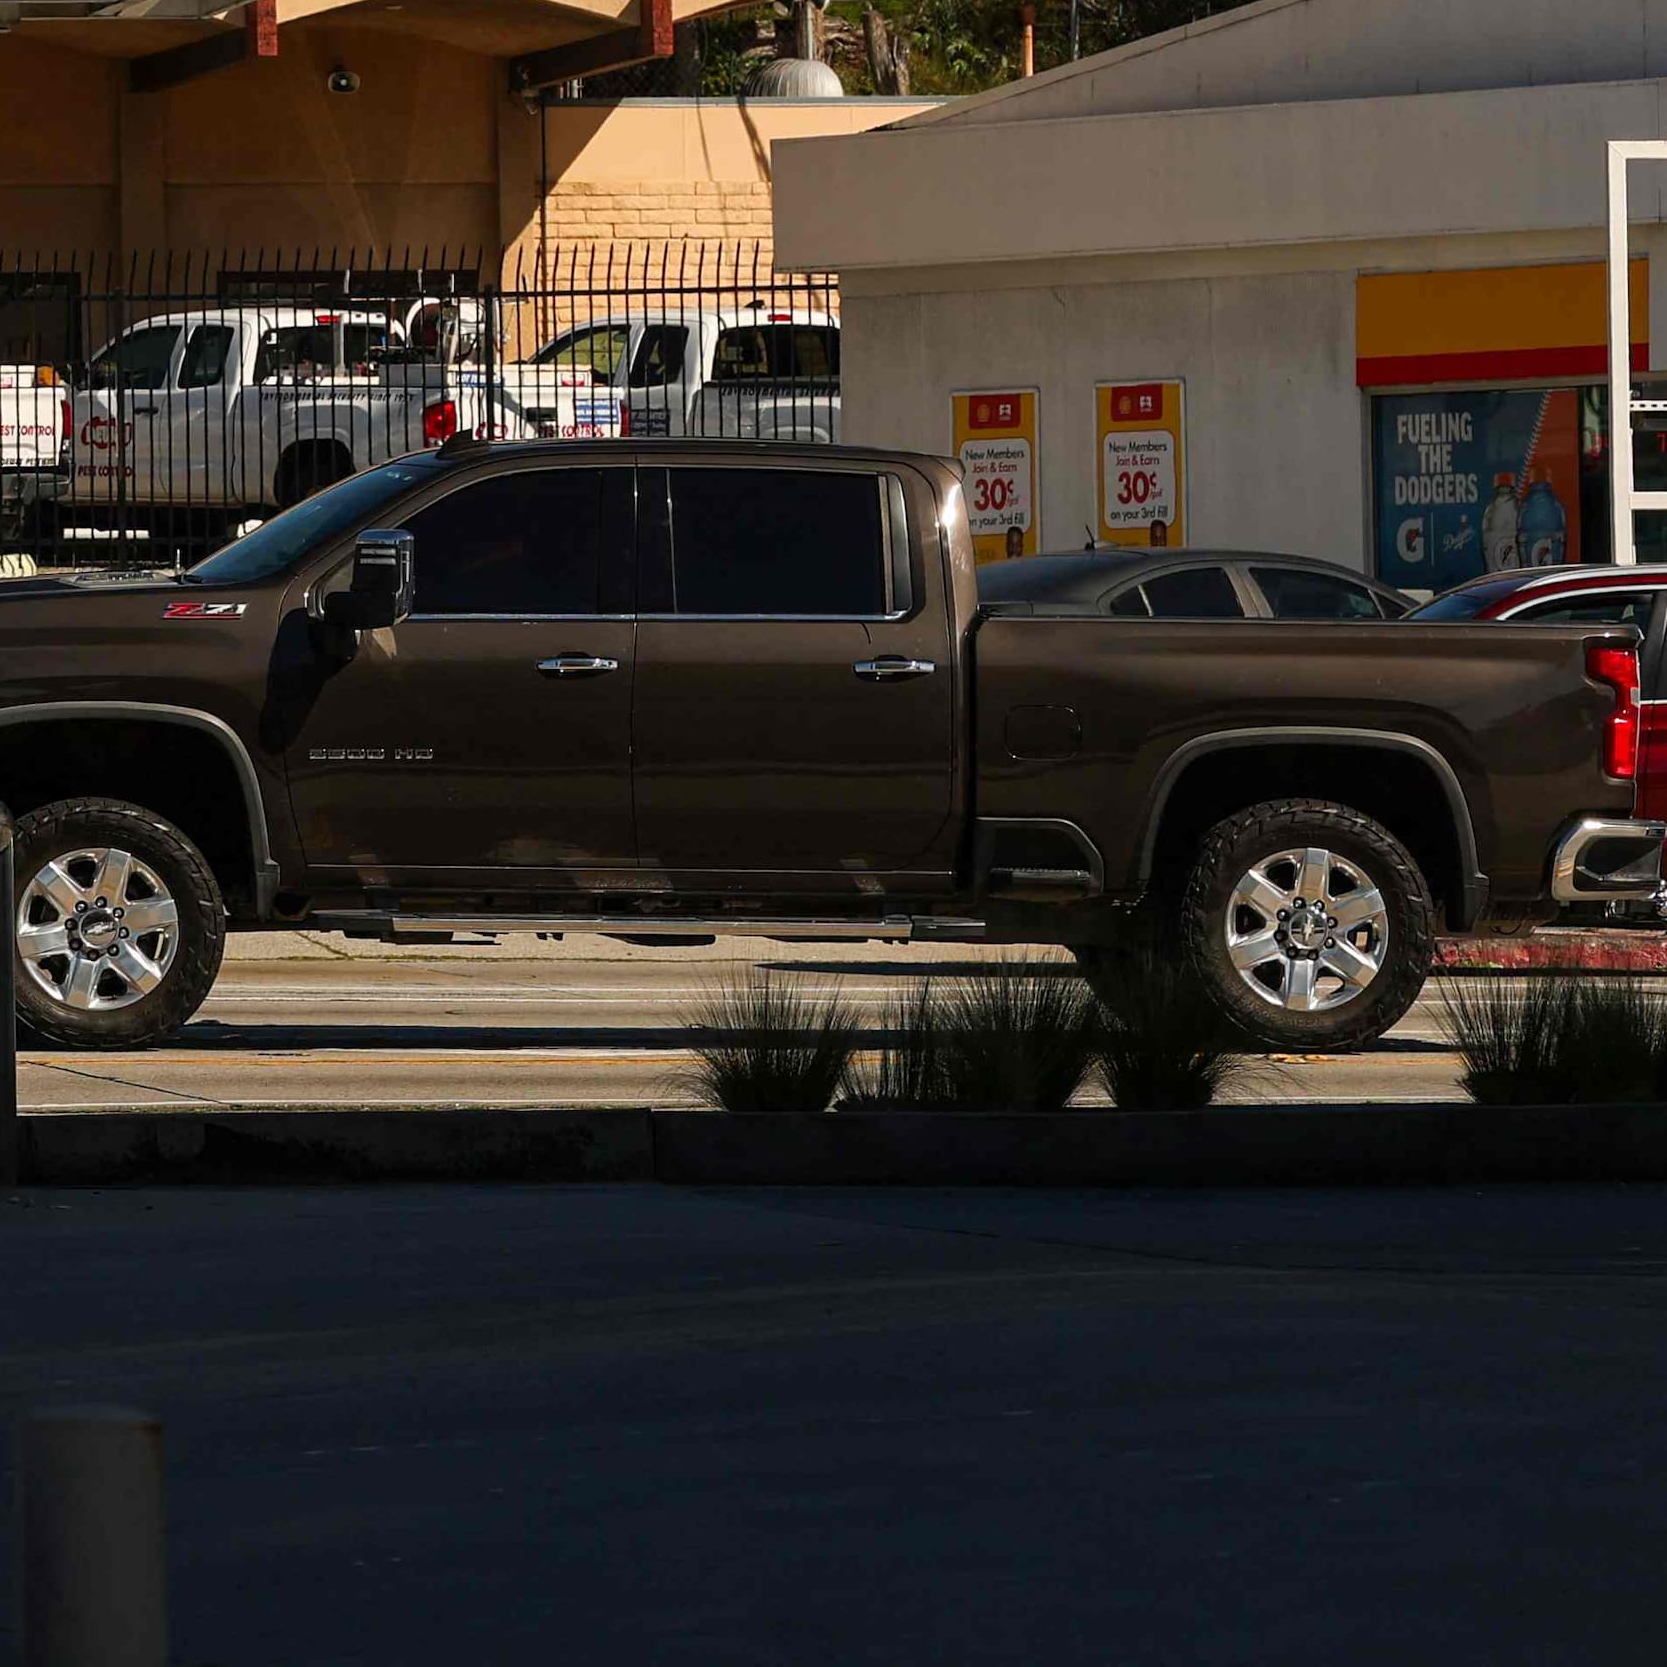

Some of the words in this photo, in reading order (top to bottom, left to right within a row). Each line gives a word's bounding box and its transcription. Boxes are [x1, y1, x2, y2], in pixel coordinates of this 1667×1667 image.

[1397, 412, 1473, 444] FUELING
[966, 449, 984, 460] New
[986, 448, 1024, 460] Members
[1109, 442, 1127, 453] New
[1129, 441, 1167, 453] Members
[1116, 456, 1130, 466] Join
[1131, 455, 1138, 465] &
[1140, 455, 1160, 465] Earn
[1418, 444, 1452, 474] THE
[972, 464, 987, 473] Join
[989, 464, 997, 472] &
[999, 463, 1017, 473] Earn
[1394, 473, 1478, 505] DODGERS
[978, 515, 998, 528] your
[999, 513, 1013, 525] 3rd
[1110, 510, 1121, 520] on
[1123, 509, 1140, 522] your
[1141, 506, 1155, 518] 3rd
[1157, 506, 1167, 518] fill
[163, 602, 248, 620] Z71
